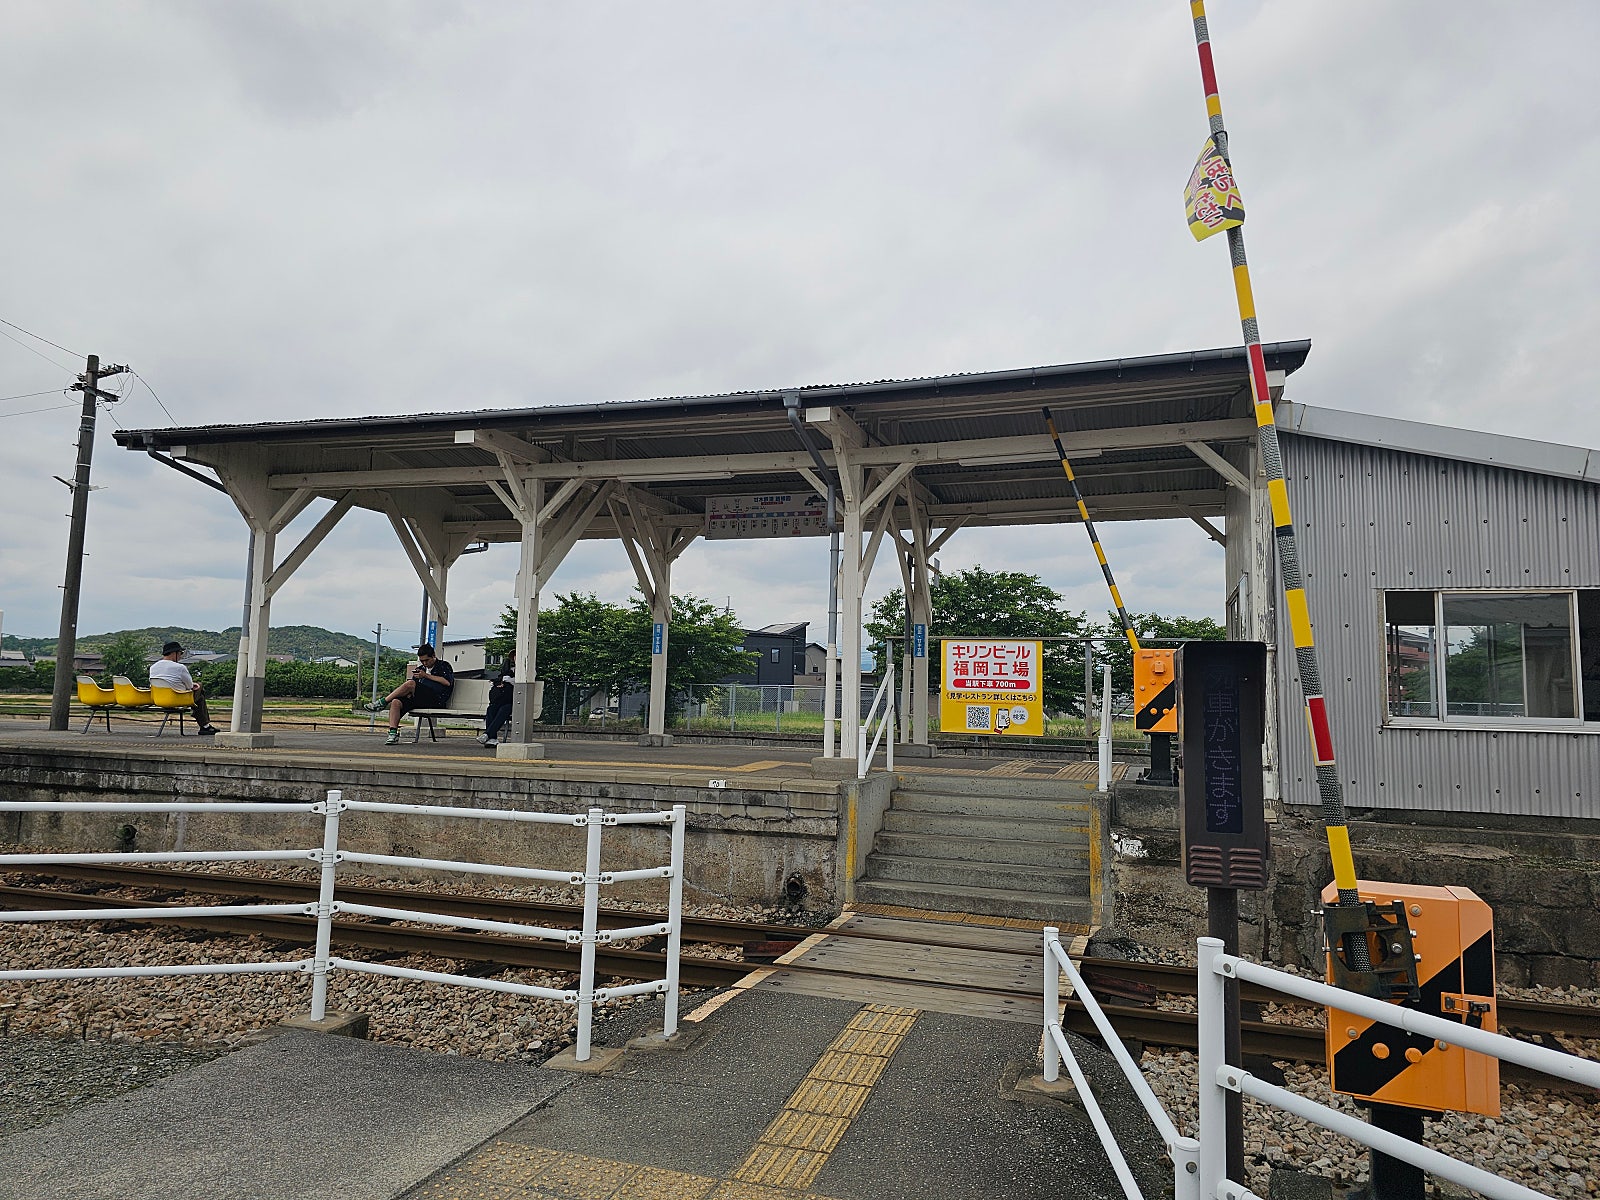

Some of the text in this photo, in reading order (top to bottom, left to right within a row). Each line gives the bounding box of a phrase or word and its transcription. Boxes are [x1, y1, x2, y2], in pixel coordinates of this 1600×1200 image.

[1201, 146, 1242, 209] しばらく
[952, 644, 1031, 660] キリンビール
[953, 660, 1030, 677] 福岡工場
[965, 680, 1017, 688] 当駅下車 700m
